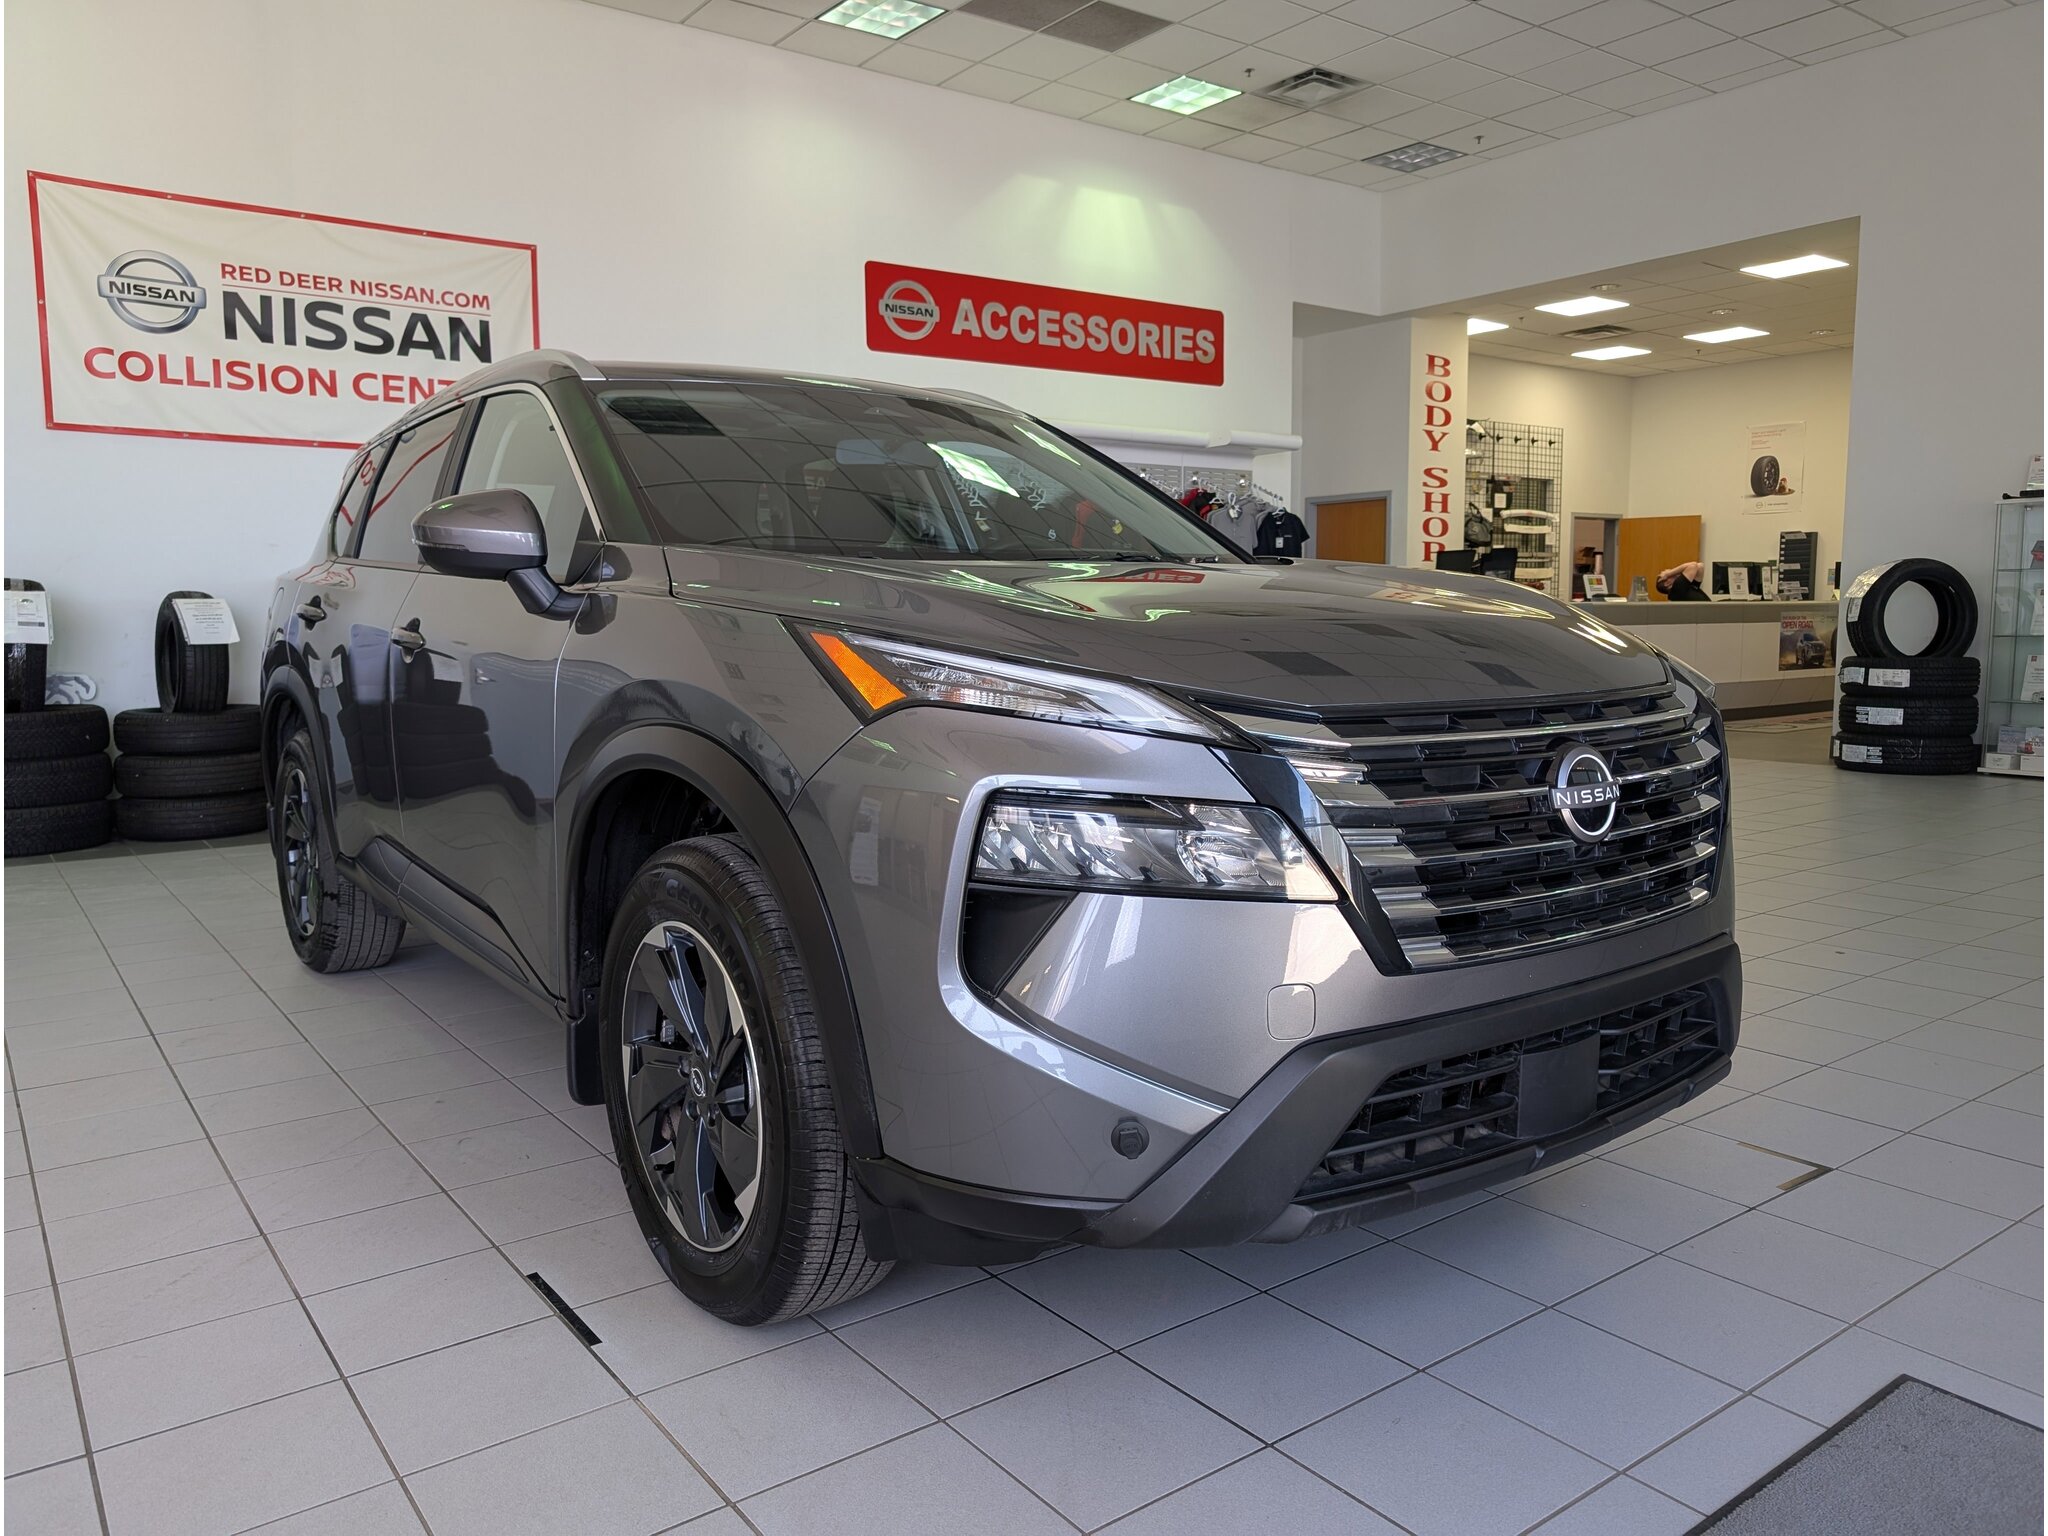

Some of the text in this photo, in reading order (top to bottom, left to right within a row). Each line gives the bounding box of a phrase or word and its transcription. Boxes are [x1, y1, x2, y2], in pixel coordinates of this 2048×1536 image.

[108, 280, 196, 304] NISSAN
[220, 262, 490, 310] RED DEER NISSAN.COM
[884, 302, 935, 319] NISSAN
[222, 290, 493, 364] NISSAN
[951, 298, 1216, 365] ACCESSORIES
[83, 347, 338, 398] COLLISION
[1423, 354, 1452, 452] BODY
[1421, 467, 1451, 562] SHOP
[1782, 621, 1797, 629] OPEN
[1556, 784, 1620, 806] NISSAN
